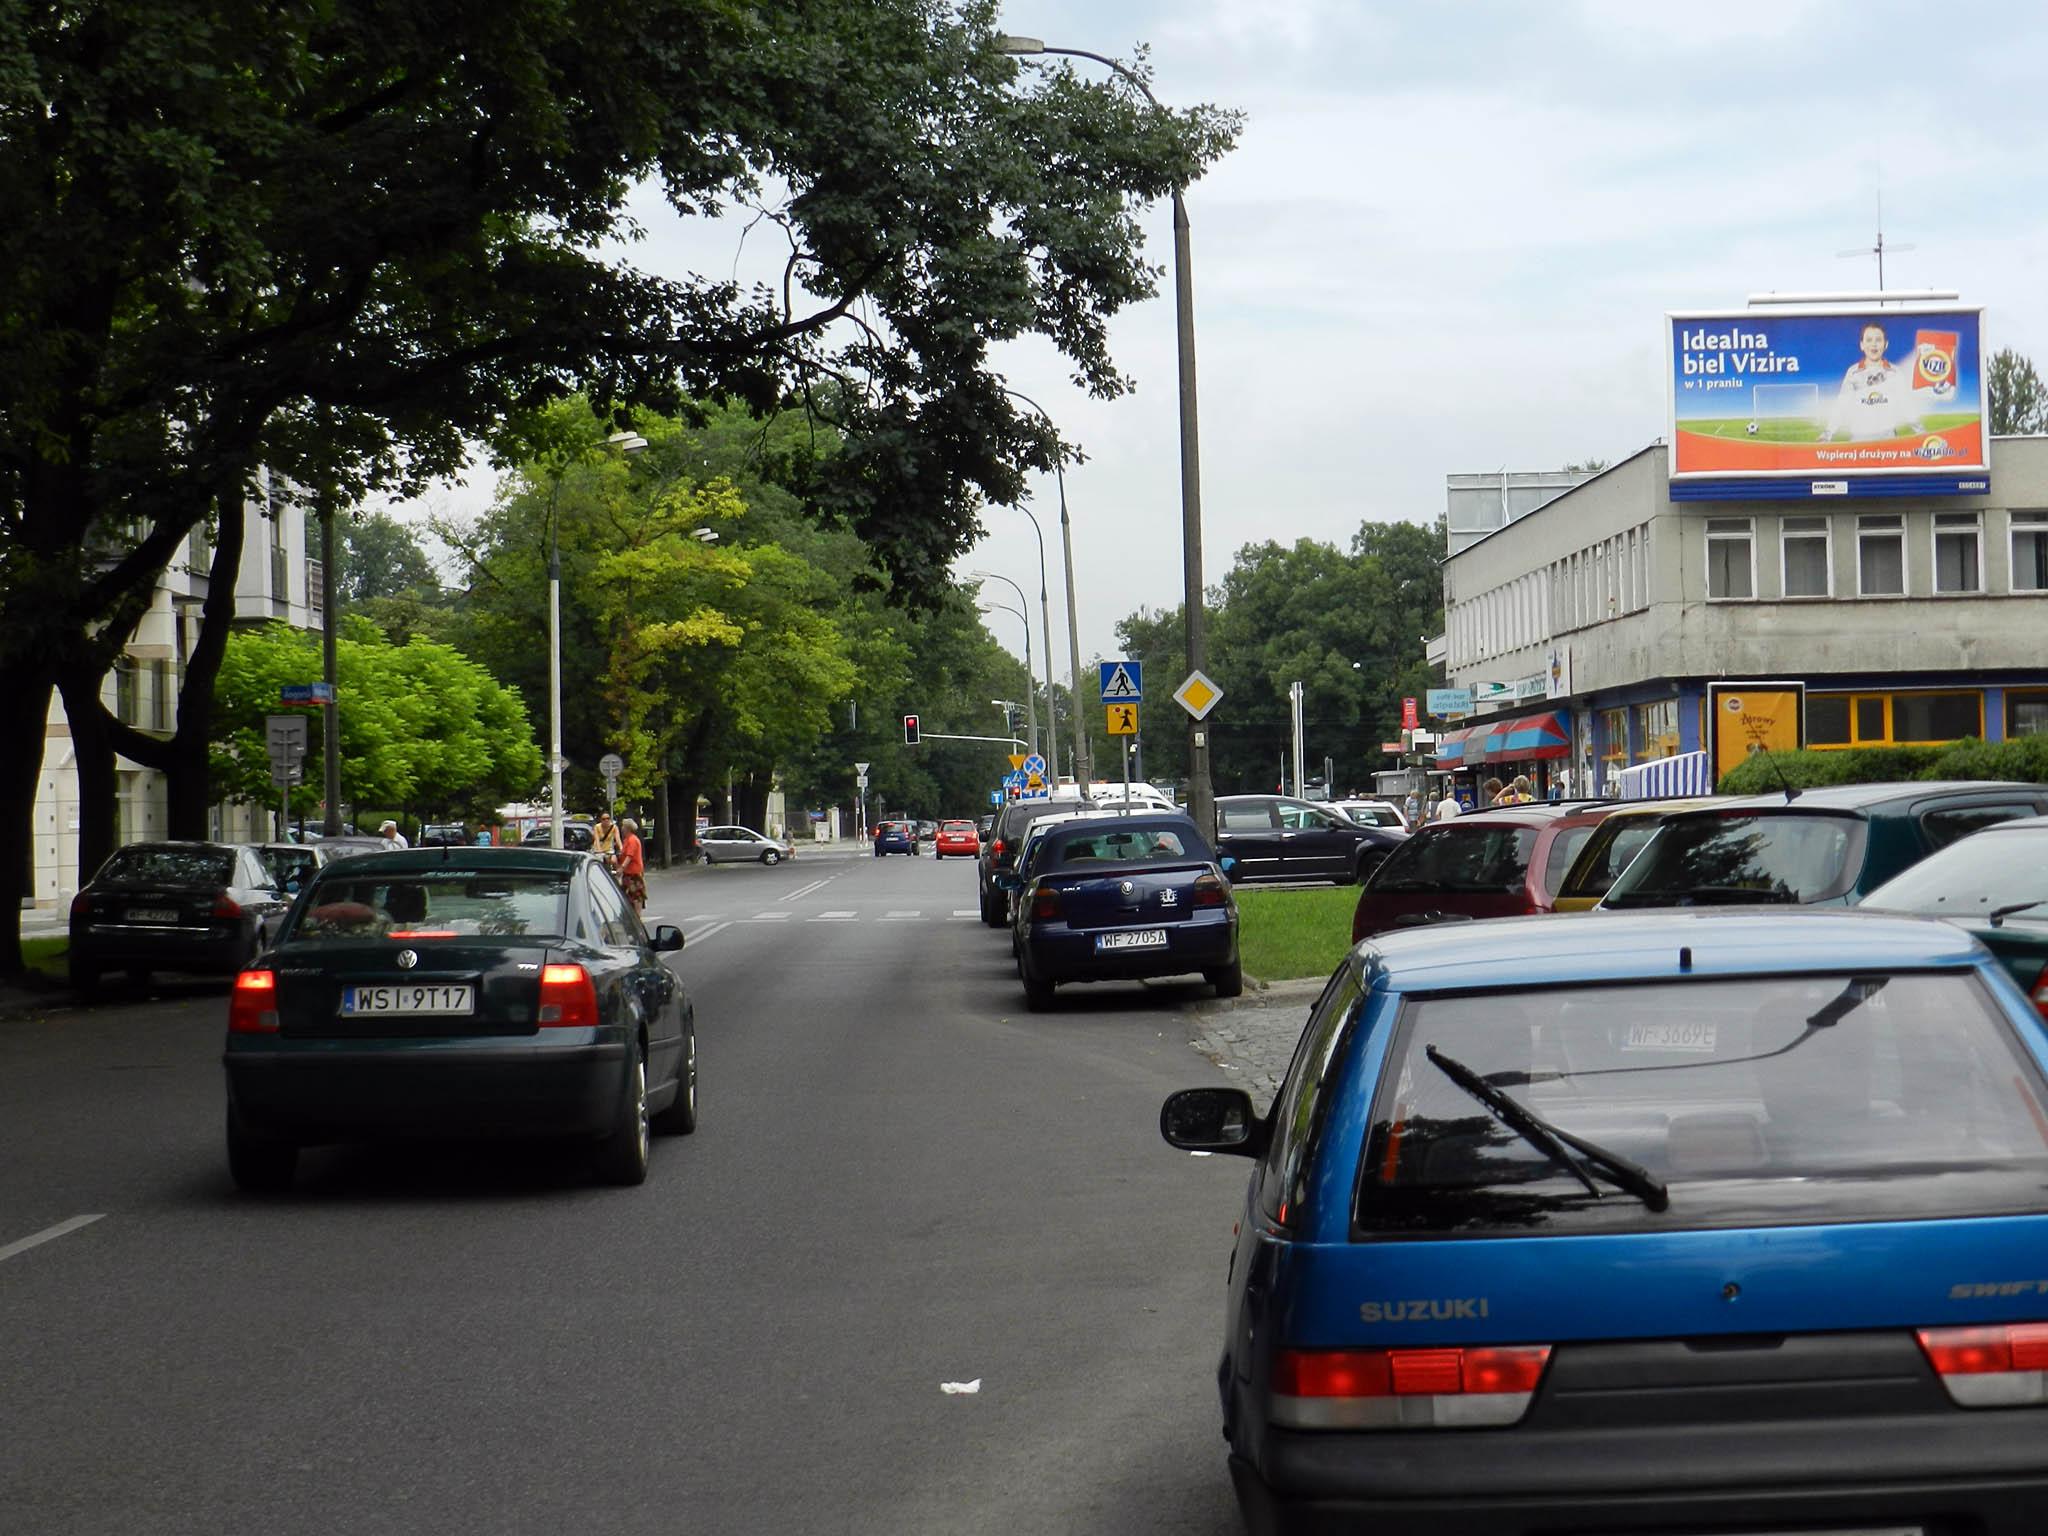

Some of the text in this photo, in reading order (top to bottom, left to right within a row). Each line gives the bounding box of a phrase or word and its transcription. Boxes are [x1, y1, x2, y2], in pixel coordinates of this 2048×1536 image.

[1682, 327, 1768, 351] Idealna
[1683, 351, 1800, 375] biel Vizira
[1684, 377, 1743, 391] w 1 praniu
[1816, 448, 1857, 461] Wspieraj
[1859, 448, 1898, 460] drużyny
[1899, 450, 1912, 459] na
[1104, 930, 1166, 947] WF 2705A
[412, 988, 466, 1009] 9T17
[1359, 1297, 1489, 1323] SUZUKI
